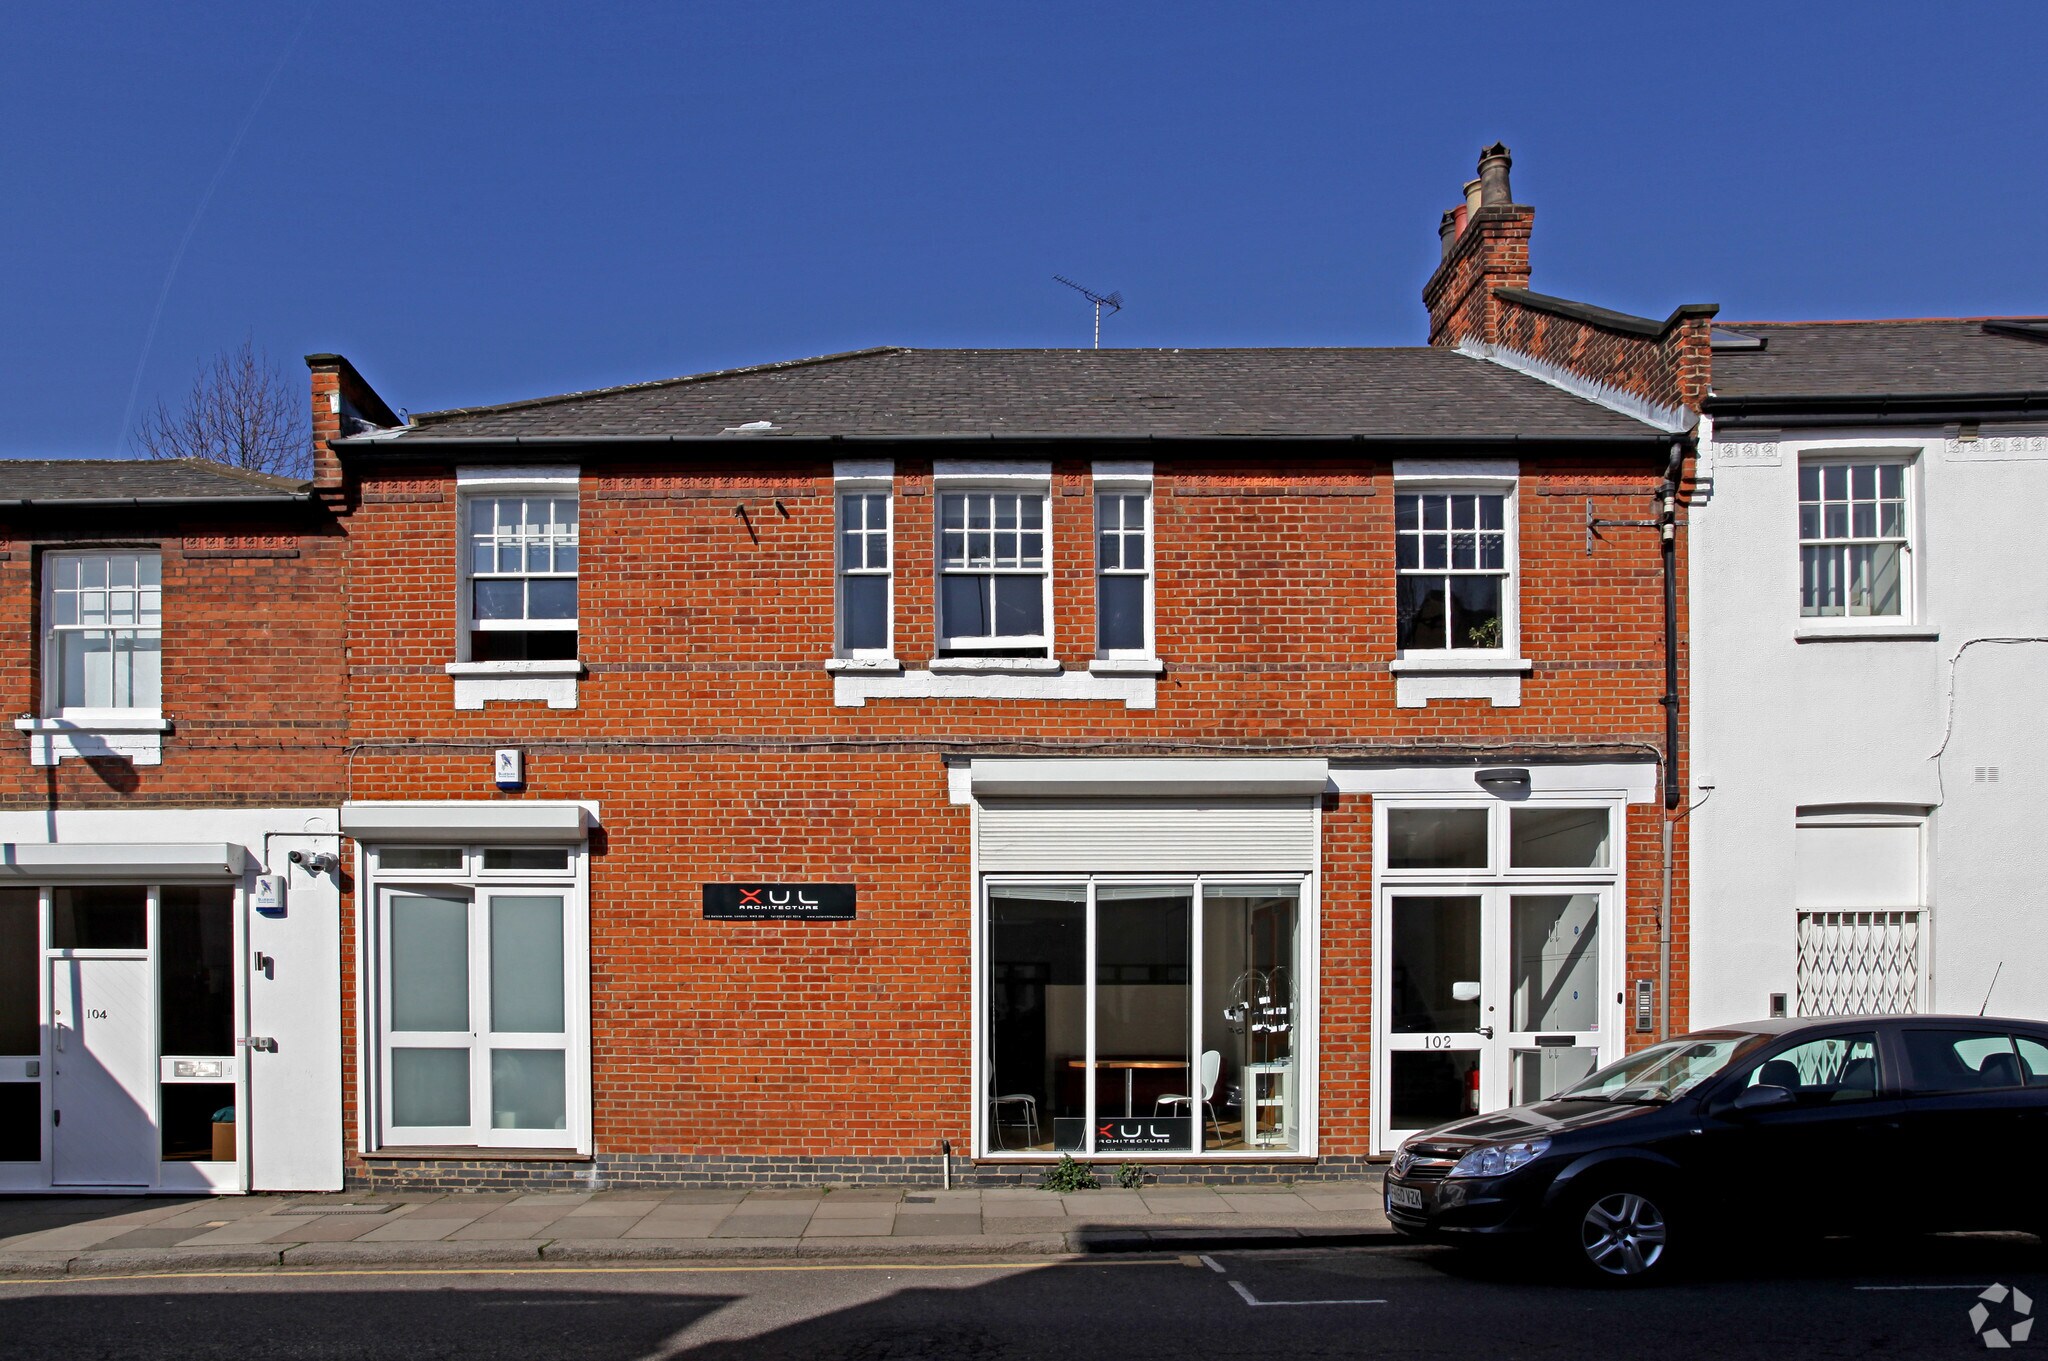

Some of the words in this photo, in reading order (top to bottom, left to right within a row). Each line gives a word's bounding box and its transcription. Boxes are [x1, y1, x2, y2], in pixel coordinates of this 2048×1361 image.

[739, 889, 819, 904] XUL
[87, 1009, 107, 1019] 104
[1424, 1035, 1451, 1049] 102
[1095, 1123, 1170, 1138] XUL
